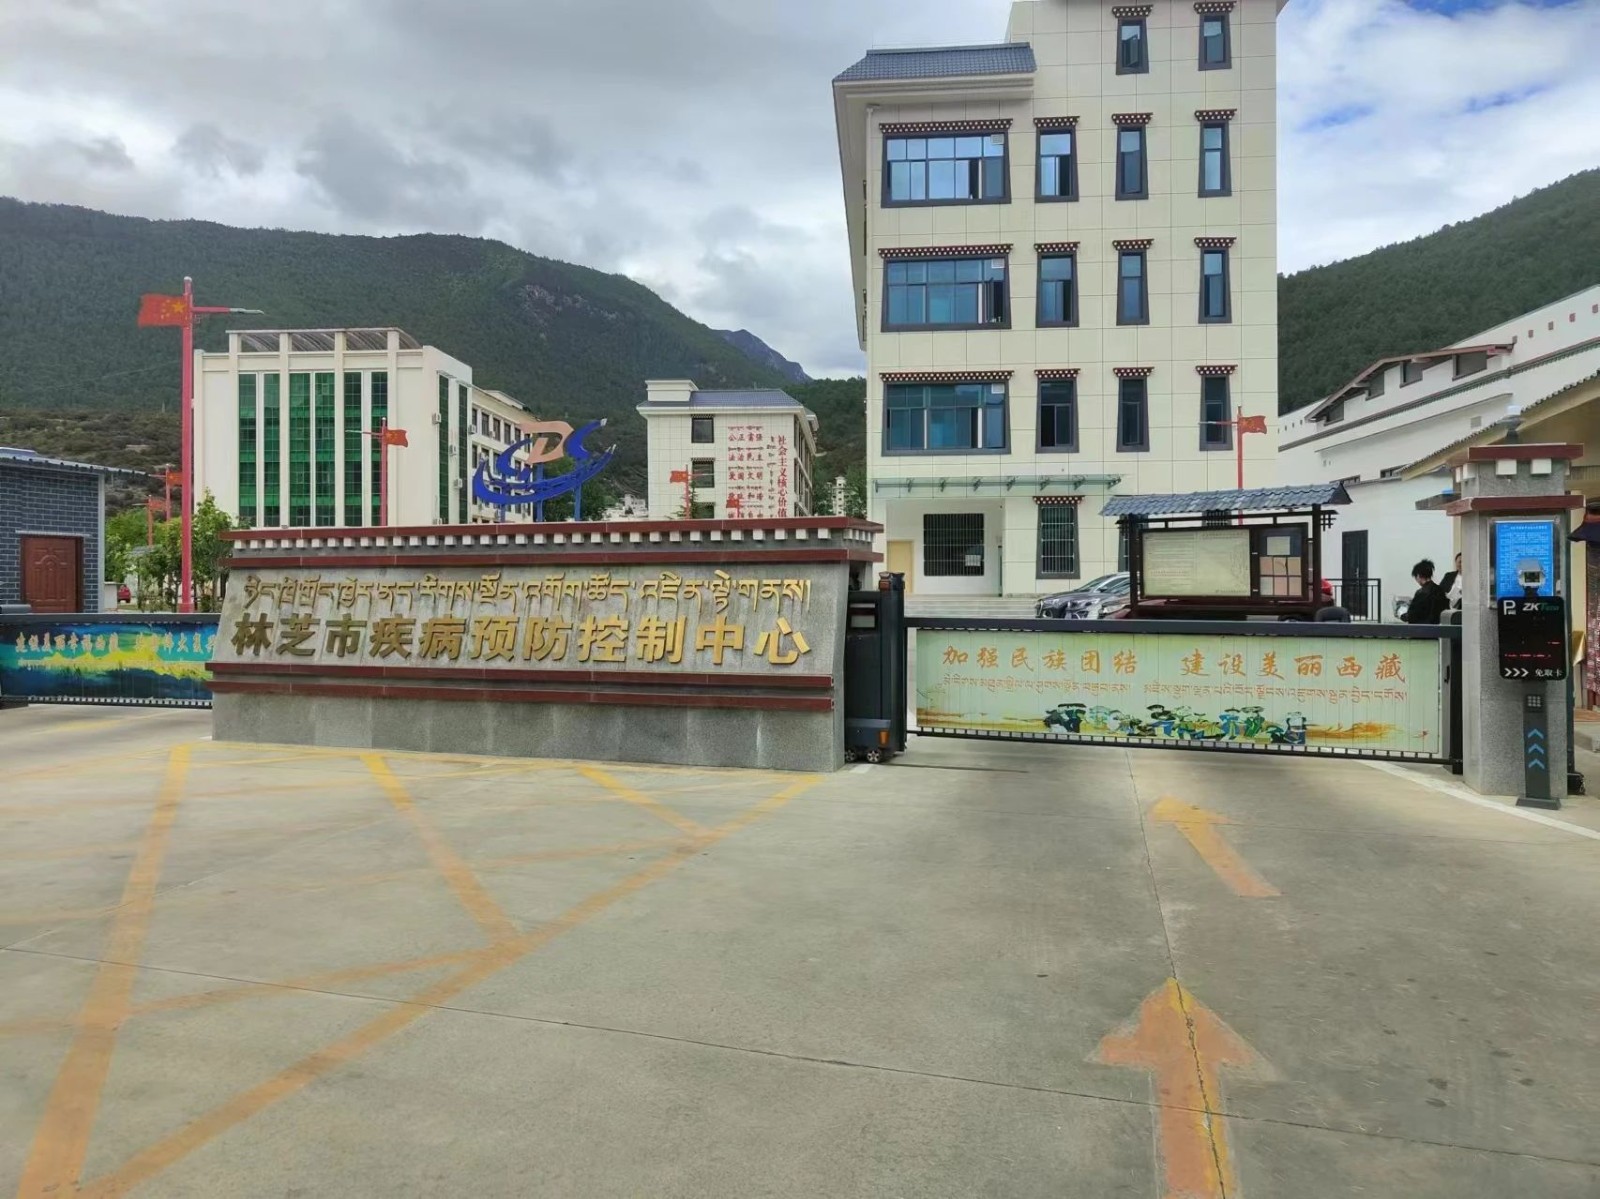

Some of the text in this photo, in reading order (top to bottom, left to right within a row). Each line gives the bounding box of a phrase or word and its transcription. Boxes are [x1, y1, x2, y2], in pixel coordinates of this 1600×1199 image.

[230, 612, 812, 665] 林芝市疾病预防控制中心
[942, 645, 1407, 683] 加强民族团结 建设美丽西藏
[1535, 668, 1564, 677] 免取卡
